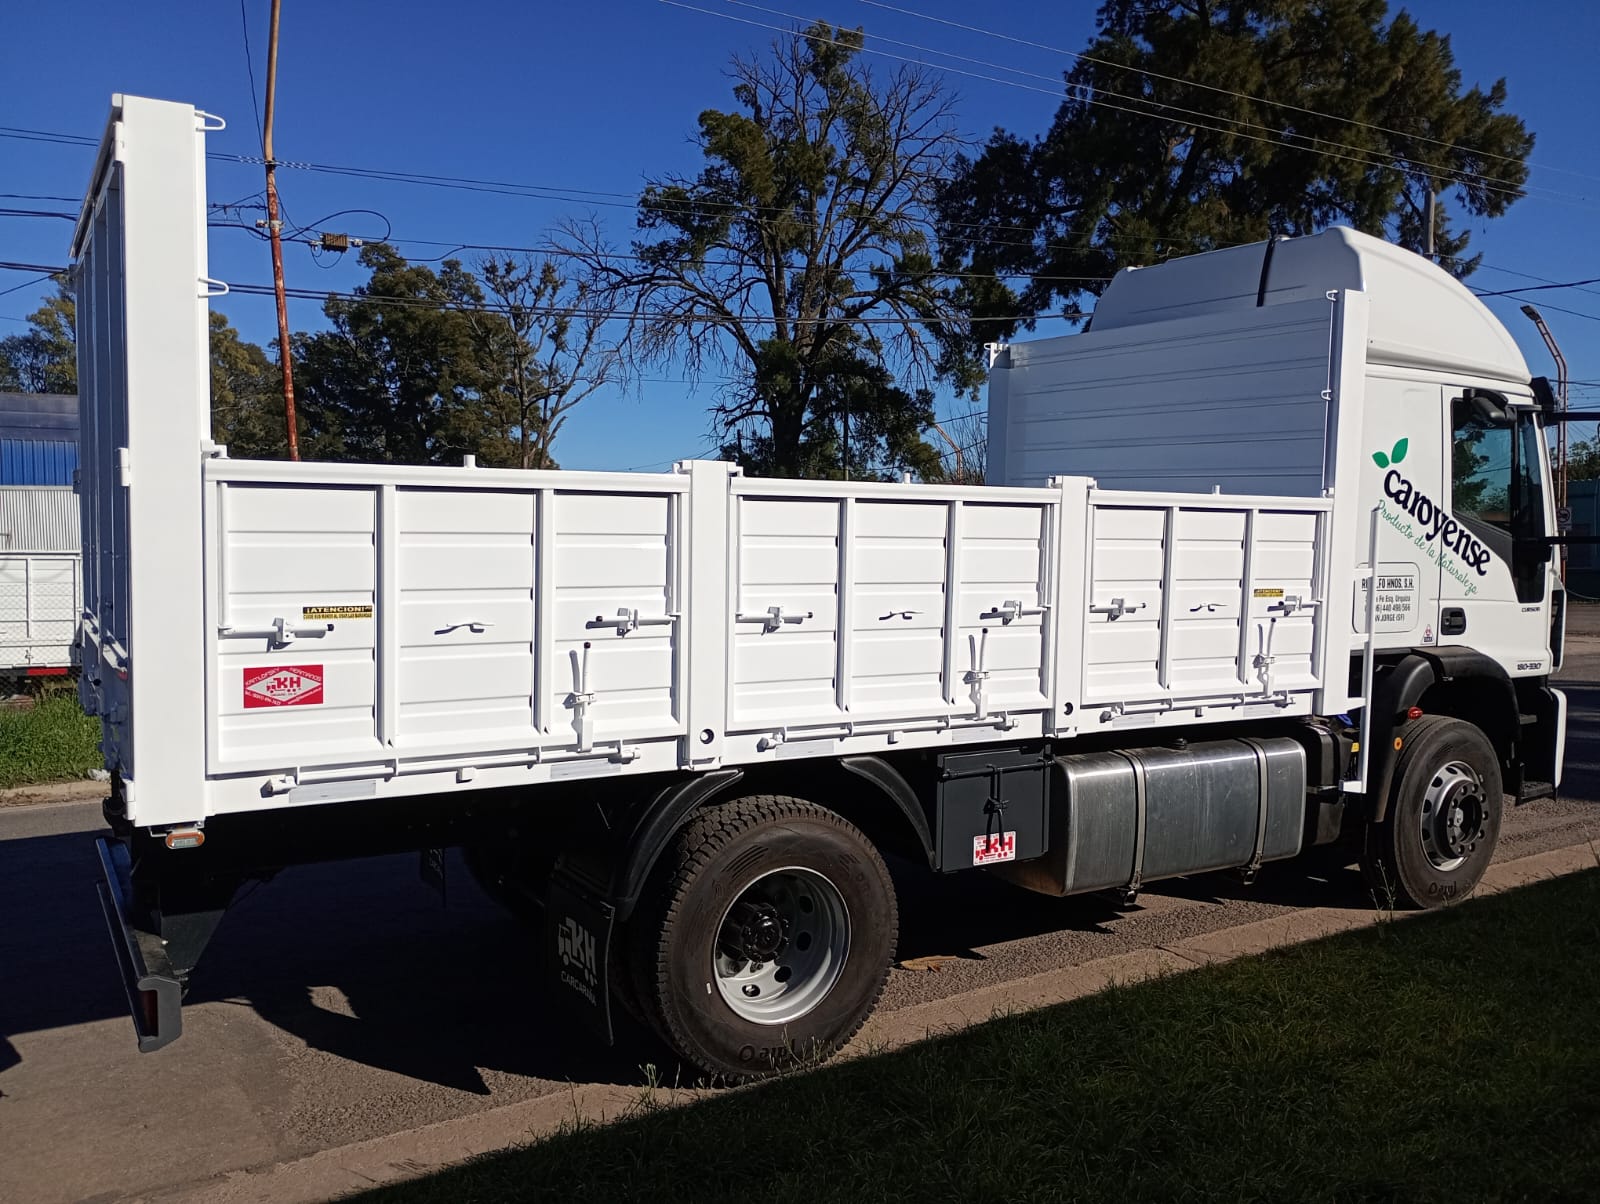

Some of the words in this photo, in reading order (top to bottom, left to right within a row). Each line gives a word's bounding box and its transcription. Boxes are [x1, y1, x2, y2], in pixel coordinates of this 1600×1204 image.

[1384, 470, 1491, 576] caroyense
[1414, 532, 1426, 549] de
[1426, 543, 1436, 560] la
